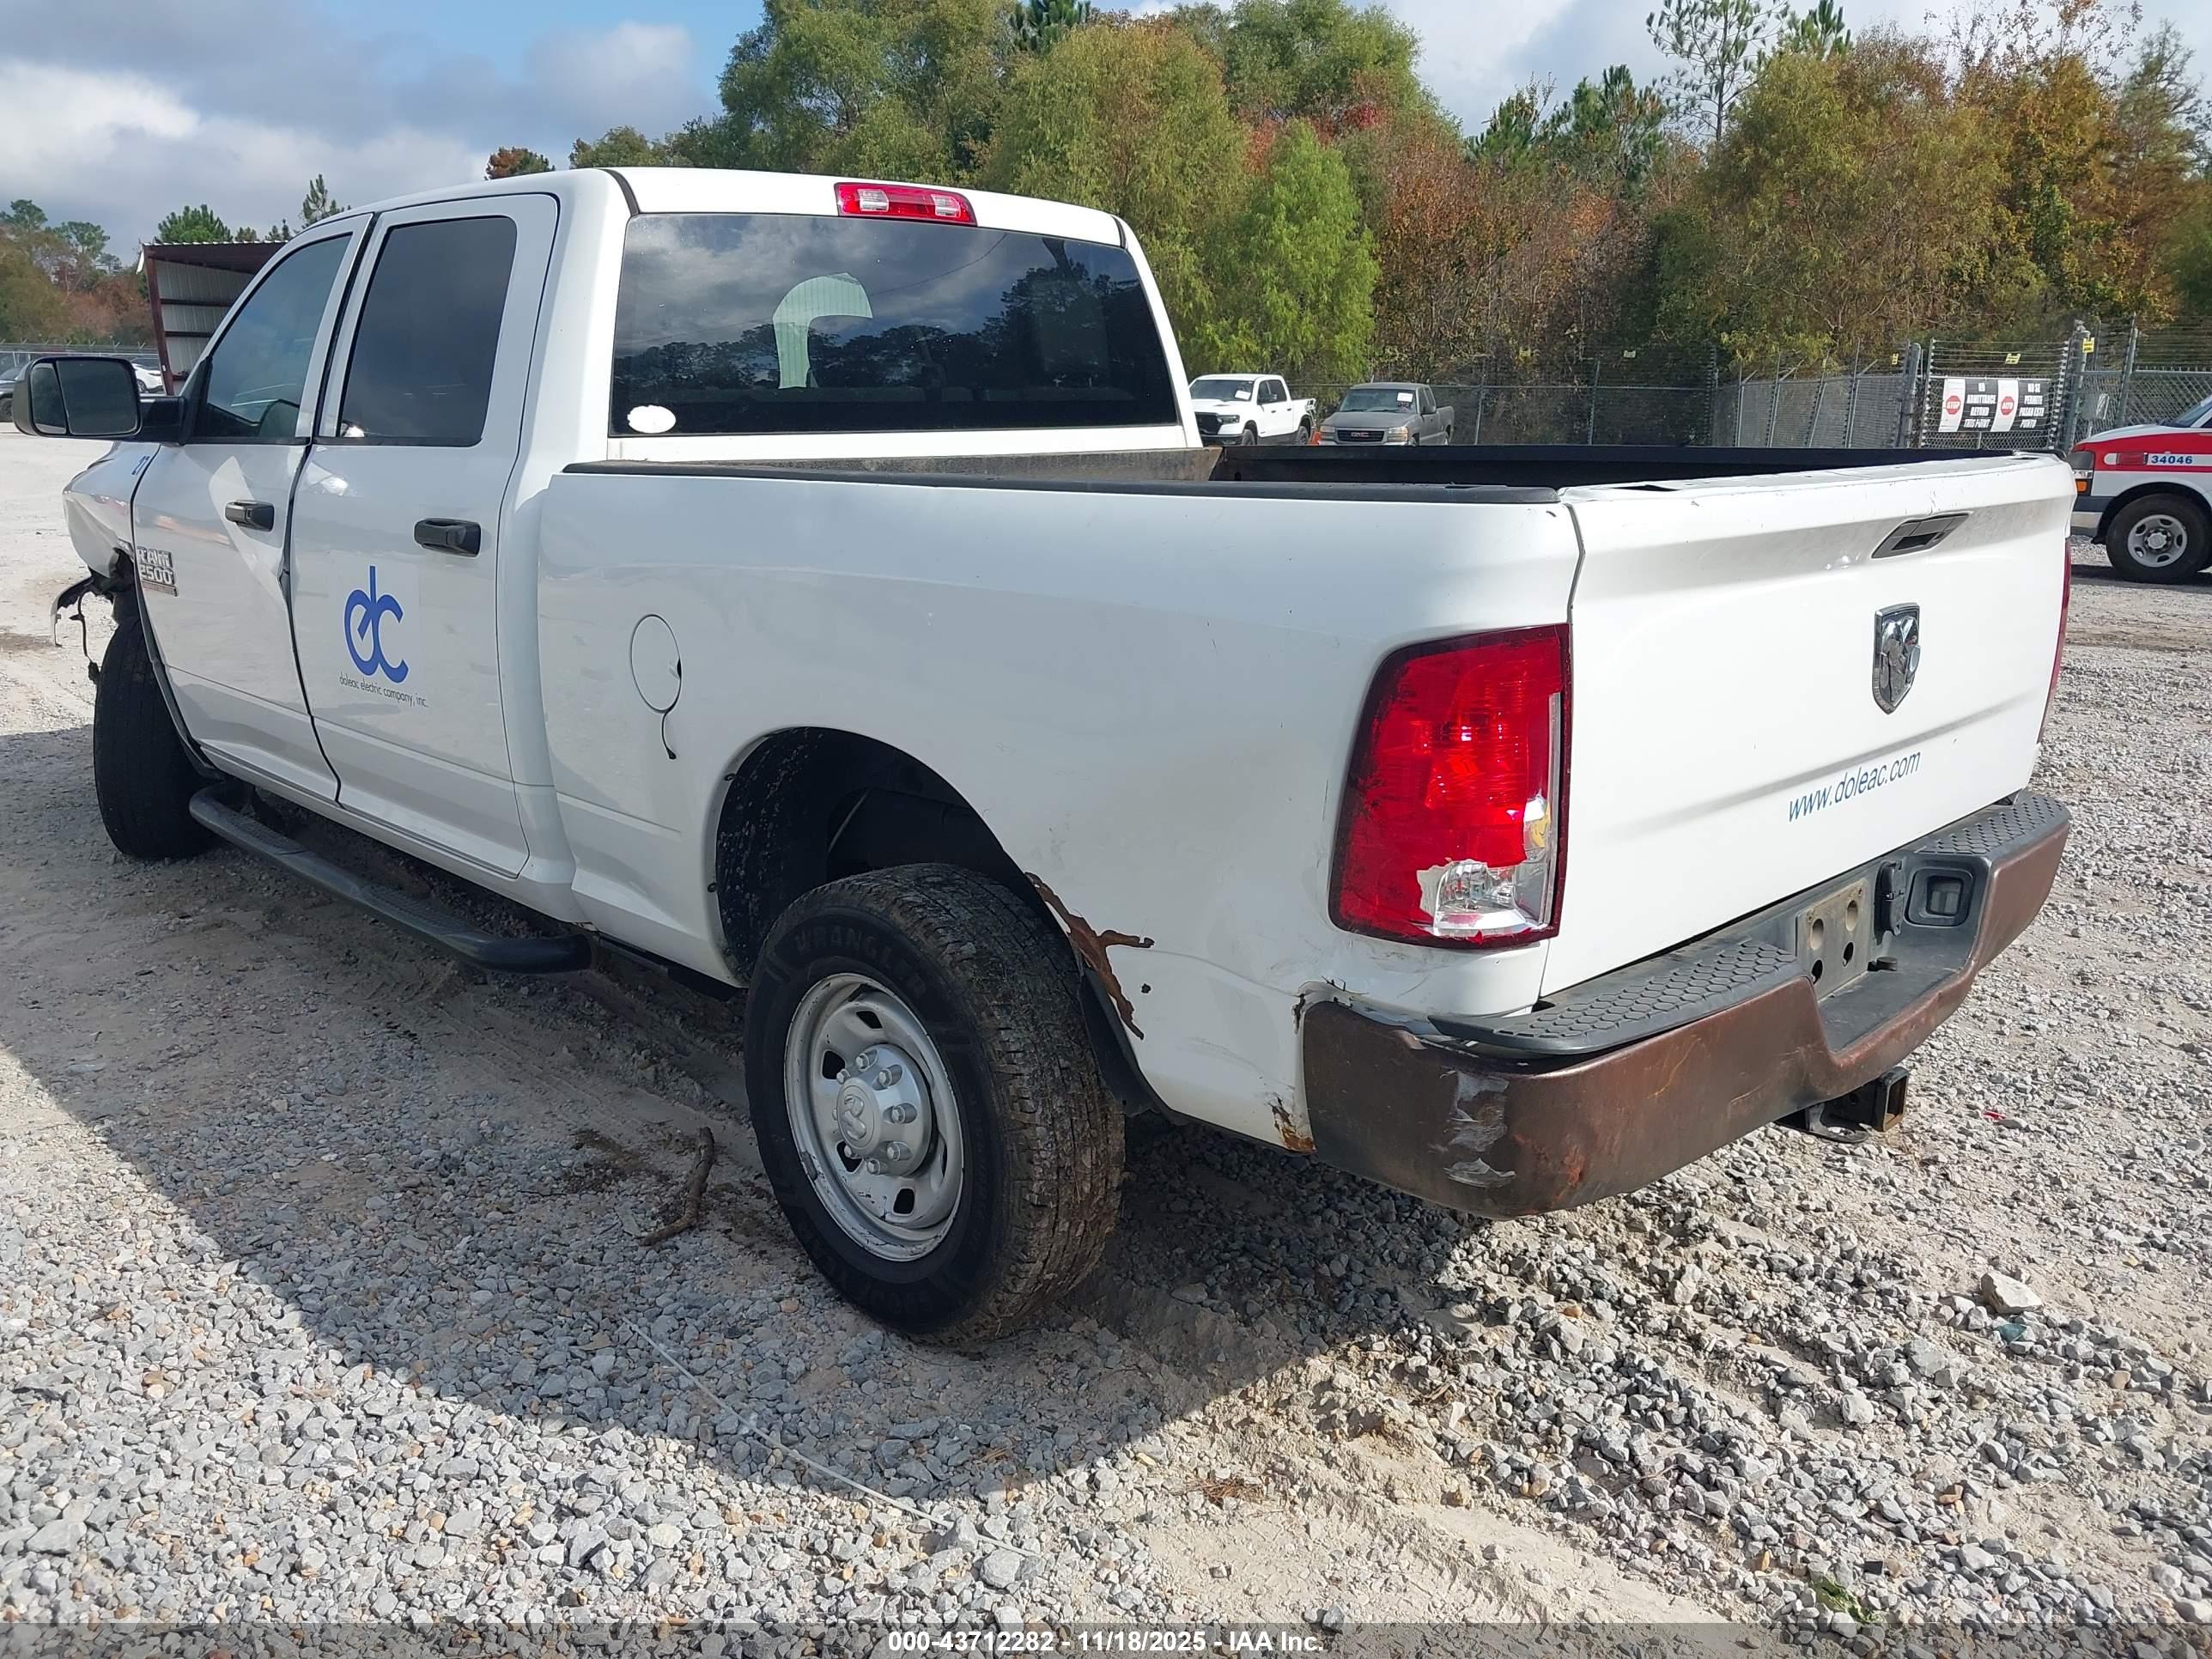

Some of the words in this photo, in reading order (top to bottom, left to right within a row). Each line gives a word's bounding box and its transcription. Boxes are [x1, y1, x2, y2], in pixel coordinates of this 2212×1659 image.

[1947, 401, 1960, 410] STOP
[2151, 455, 2193, 465] 34046
[137, 547, 172, 568] RAM
[139, 563, 174, 585] 2500
[339, 671, 360, 690] doleac
[360, 678, 382, 696] electric
[416, 693, 429, 708] inc.
[1789, 751, 1921, 822] www.doleac.com
[794, 925, 927, 1000] WRANGLER
